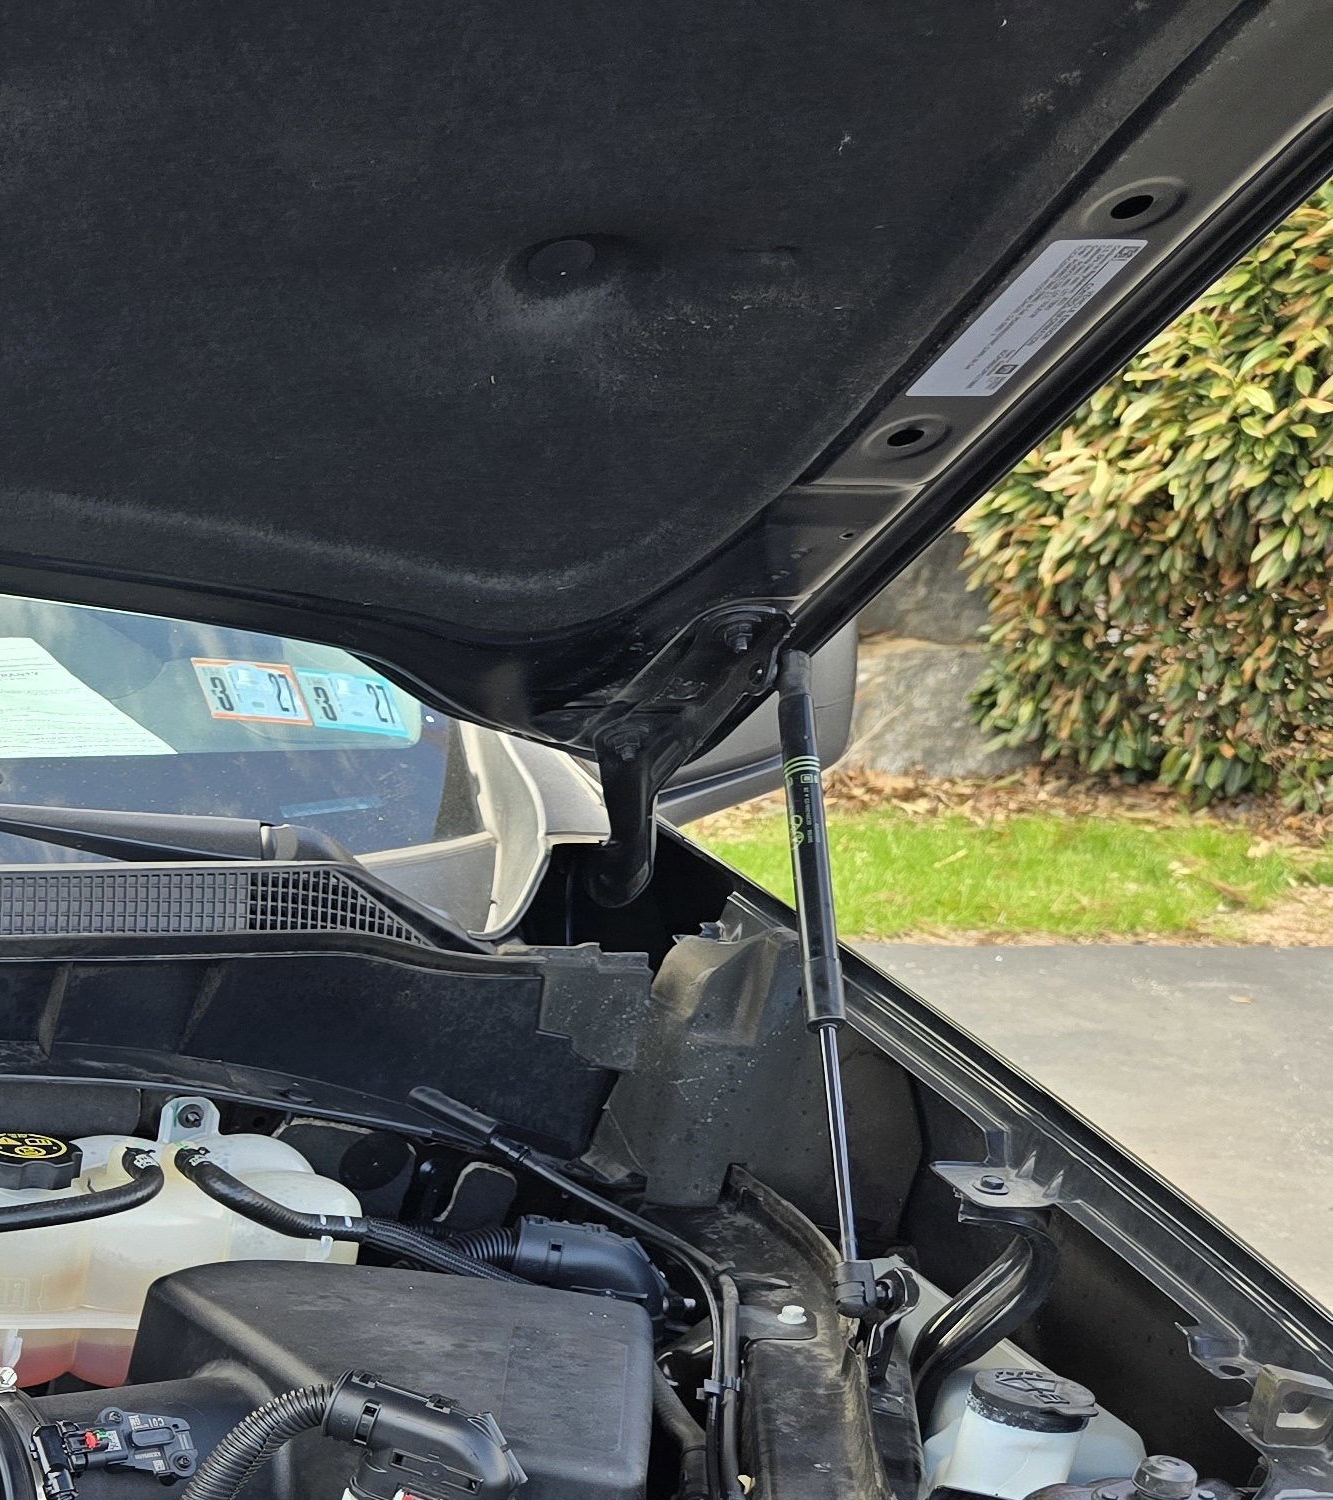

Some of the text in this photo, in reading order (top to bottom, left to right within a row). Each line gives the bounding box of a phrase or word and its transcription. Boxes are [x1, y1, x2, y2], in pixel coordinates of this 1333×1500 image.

[210, 672, 299, 717] 3 27
[313, 683, 396, 725] 3 27
